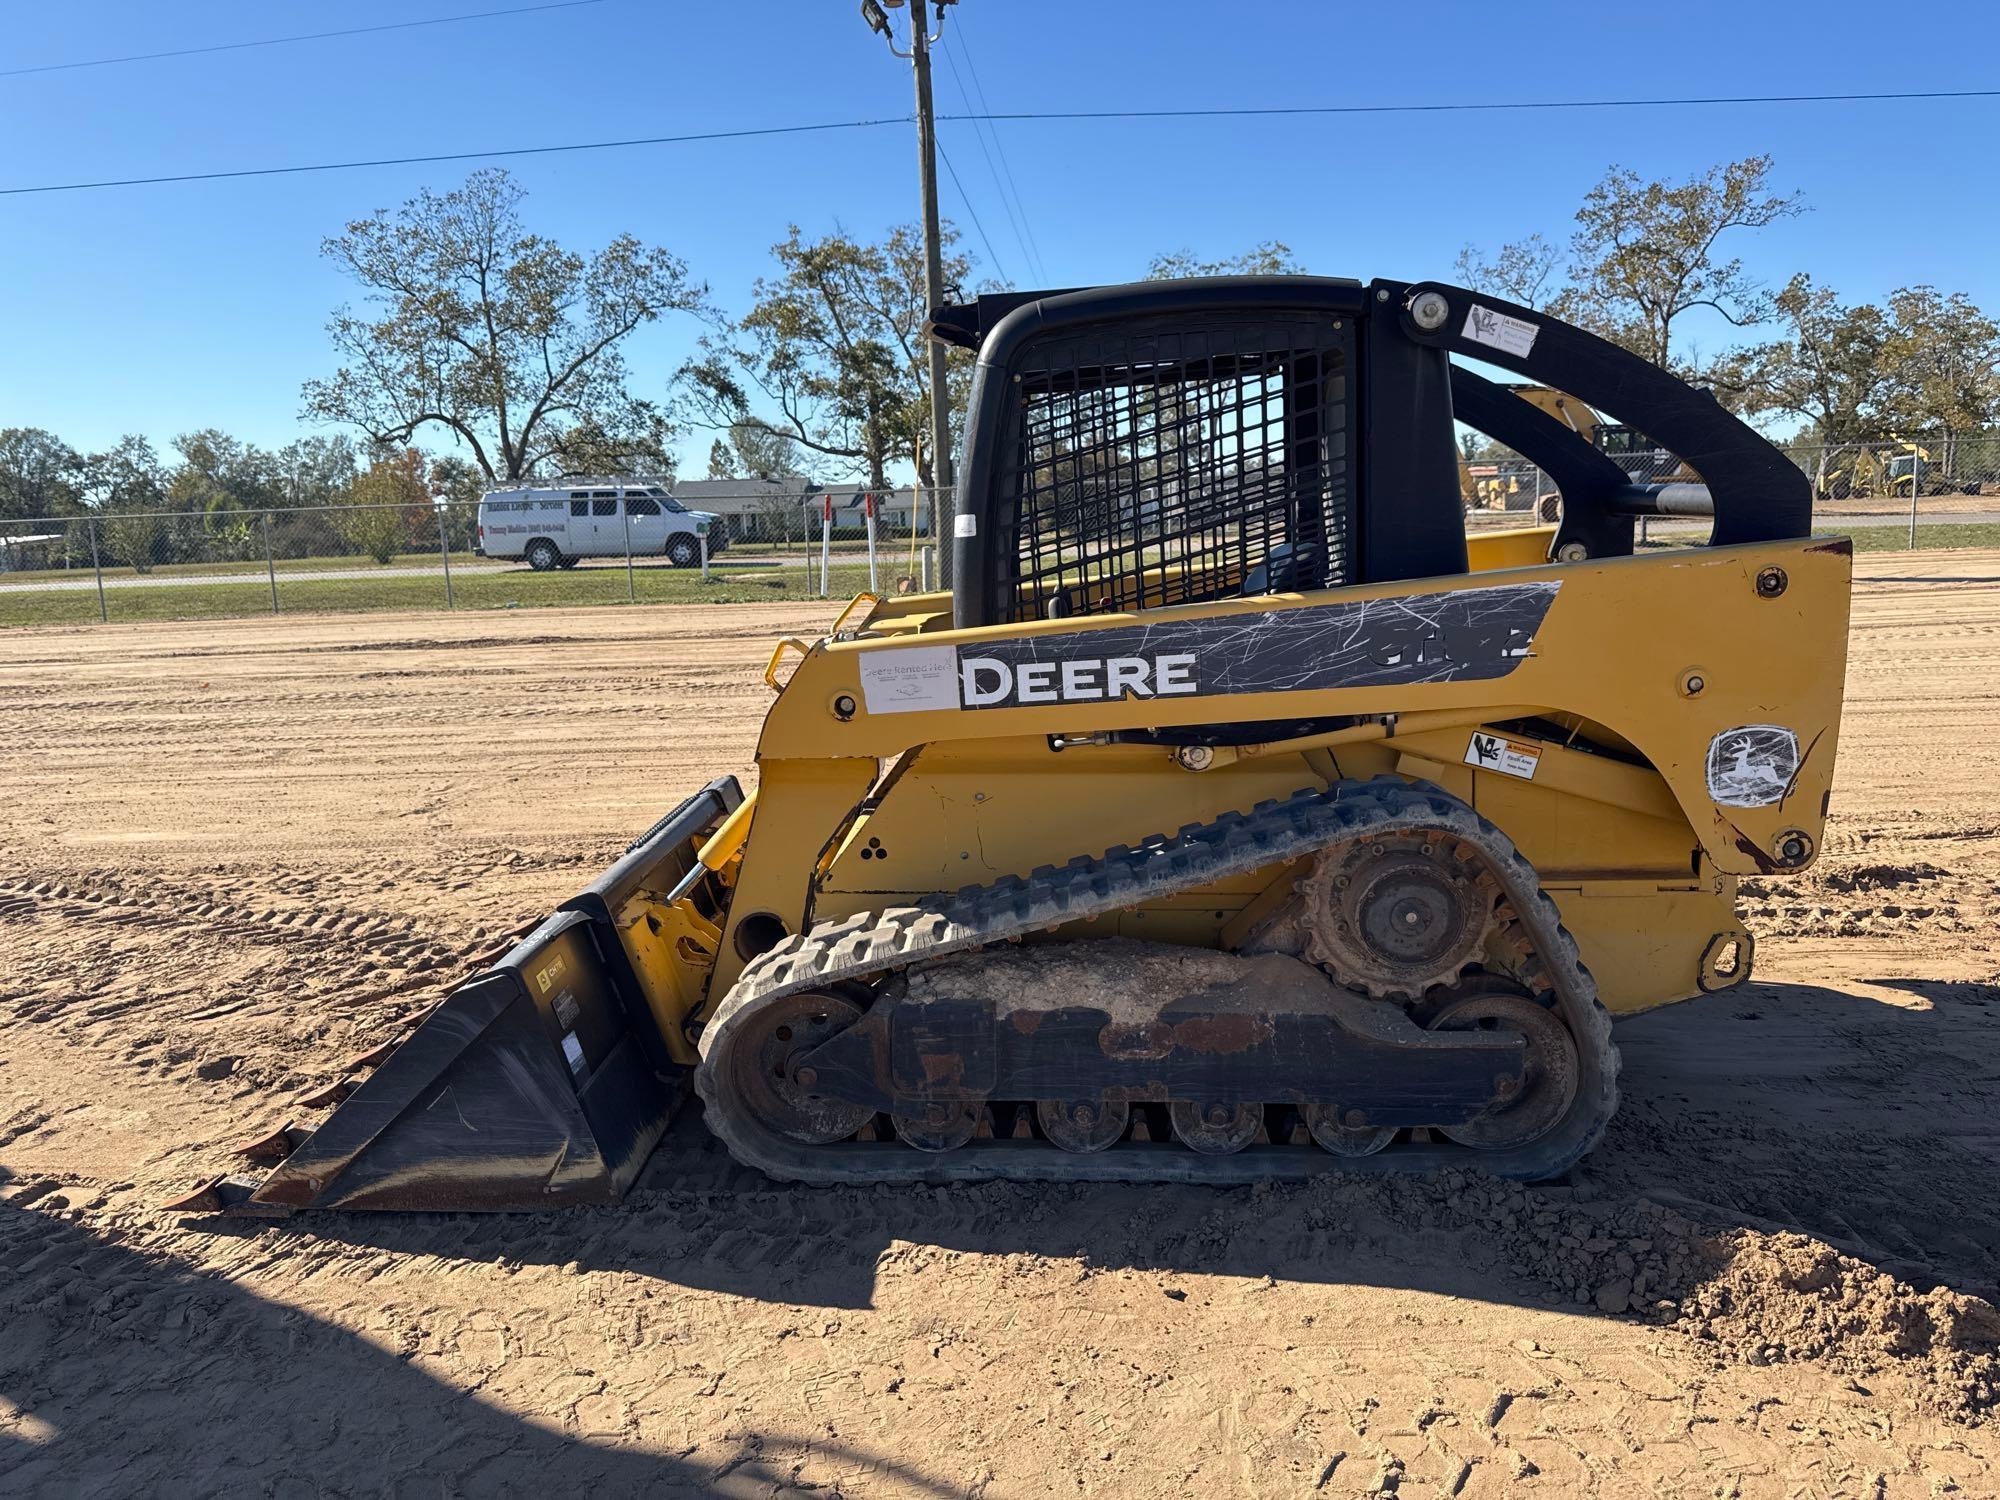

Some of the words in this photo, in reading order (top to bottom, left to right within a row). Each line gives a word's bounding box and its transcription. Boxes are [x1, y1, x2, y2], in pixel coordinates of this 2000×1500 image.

[540, 501, 564, 510] Services
[961, 653, 1198, 706] DEERE
[1511, 745, 1538, 755] WARNING
